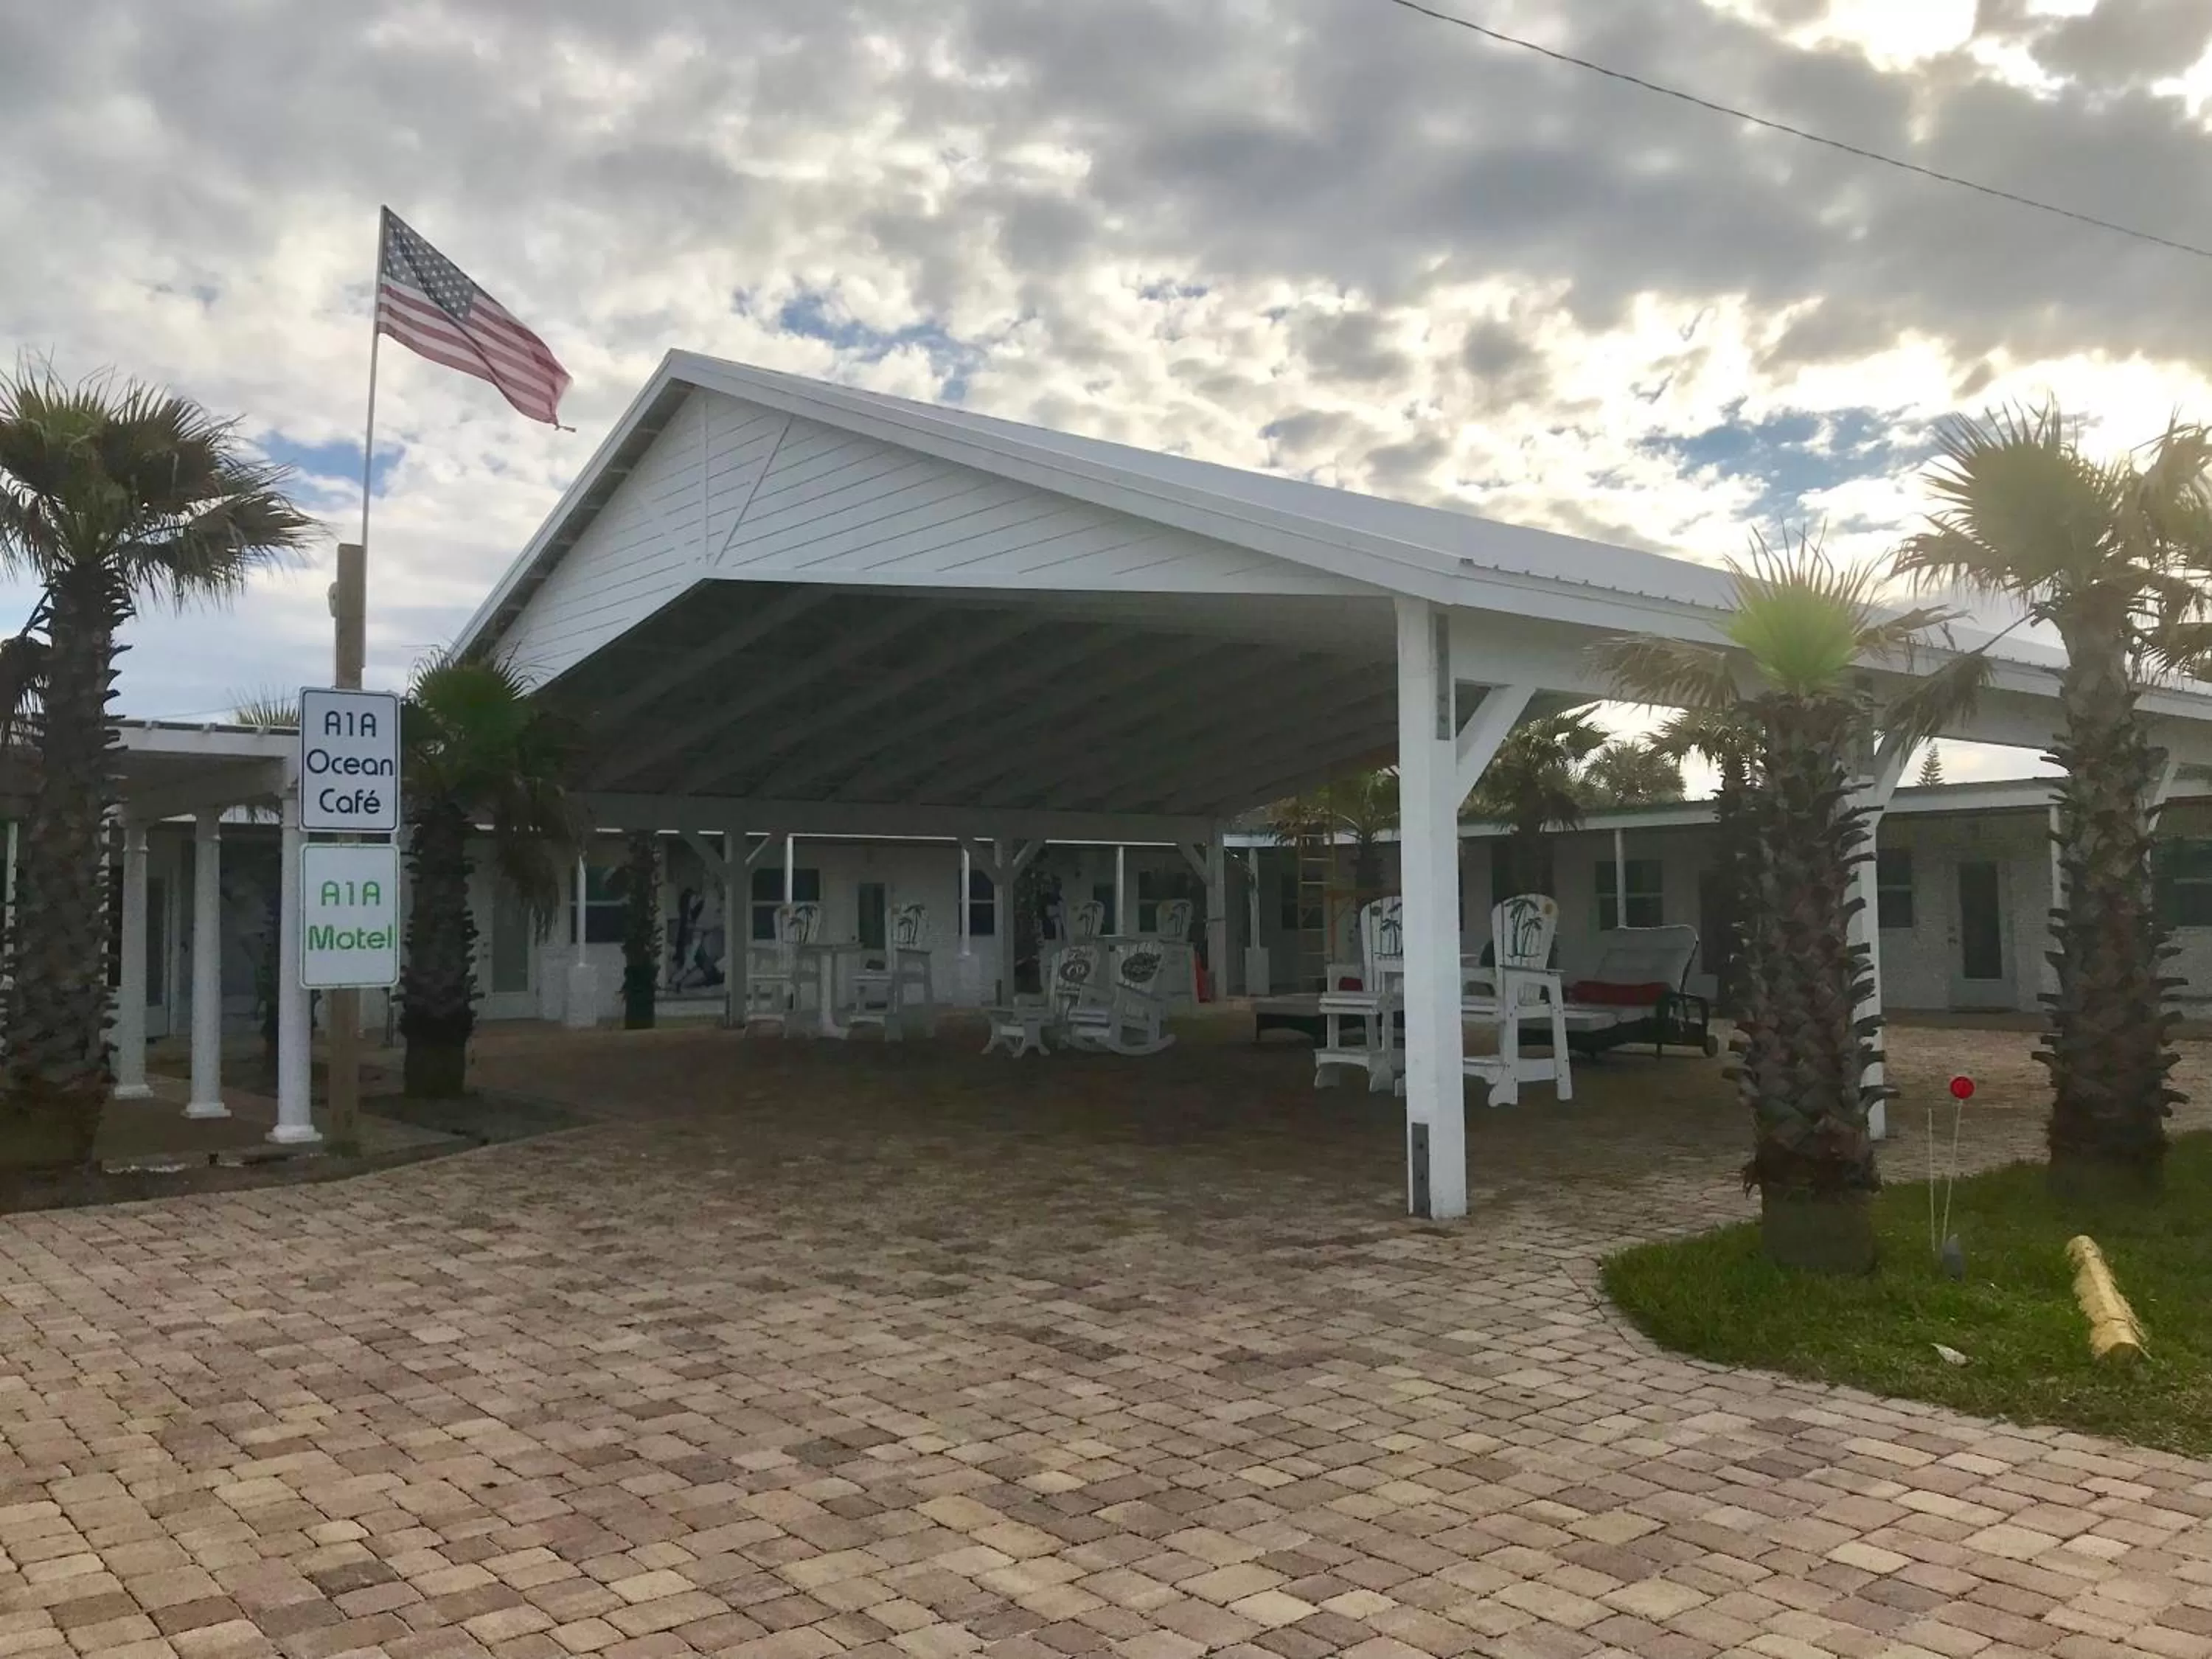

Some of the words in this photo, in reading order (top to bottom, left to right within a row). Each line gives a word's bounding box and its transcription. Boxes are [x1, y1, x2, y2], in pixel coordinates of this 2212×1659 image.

[324, 711, 376, 737] A1A
[306, 749, 394, 776] Ocean
[319, 788, 381, 814] Café
[321, 880, 380, 906] A1A
[307, 925, 392, 950] Motel
